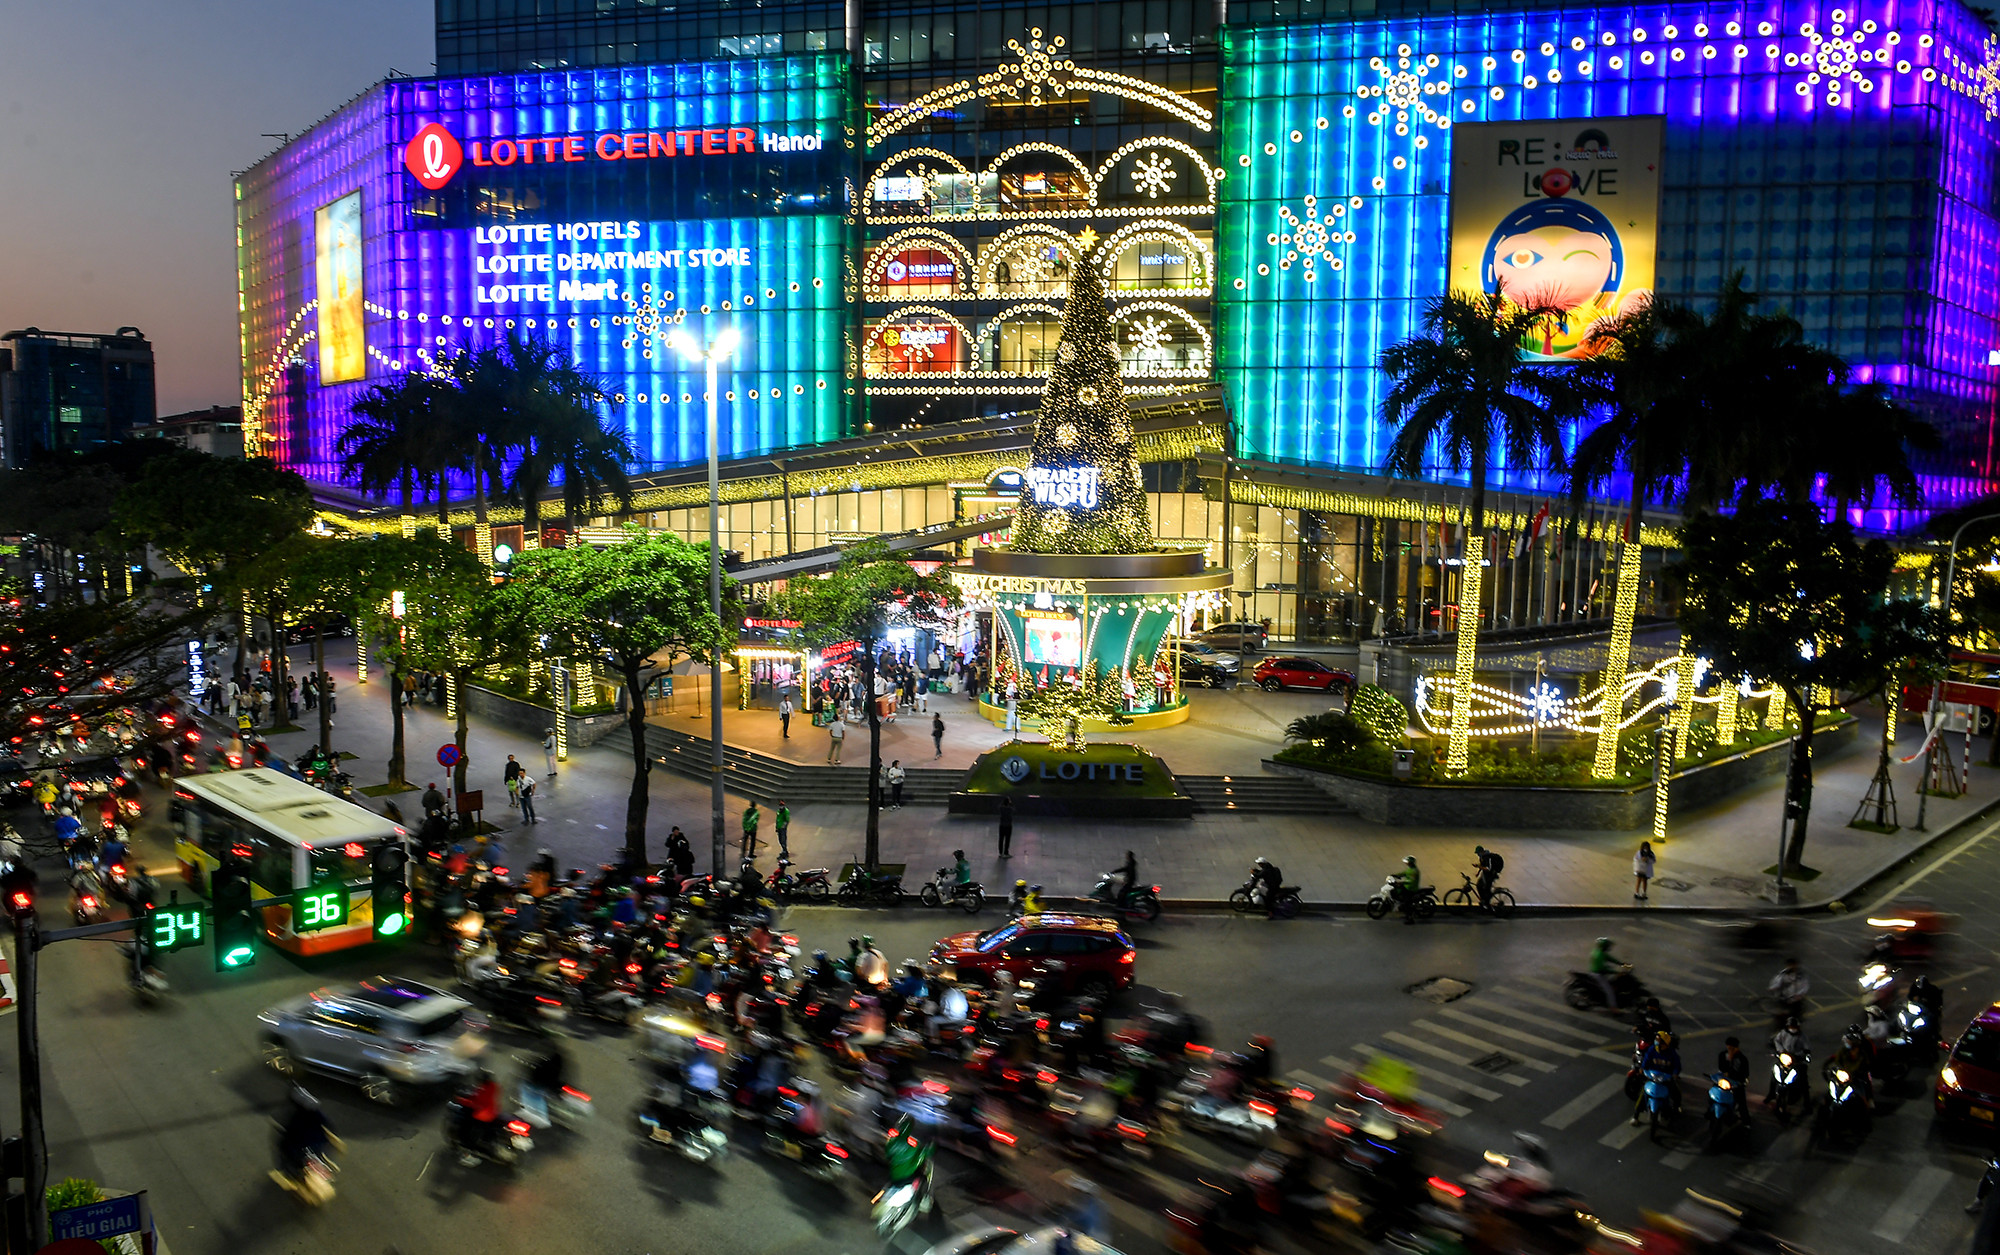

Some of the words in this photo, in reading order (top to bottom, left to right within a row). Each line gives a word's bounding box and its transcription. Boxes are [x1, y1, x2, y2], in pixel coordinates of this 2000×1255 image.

[473, 136, 585, 167] LOTTE
[596, 127, 756, 162] CENTER
[763, 130, 822, 154] Hanoi
[476, 223, 552, 245] LOTTE
[557, 220, 641, 242] HOTELS
[476, 253, 553, 275] LOTTE
[557, 249, 684, 272] DEPARTMENT
[688, 248, 751, 267] STORE
[477, 284, 553, 304] LOTTE
[558, 278, 619, 302] Mart
[988, 577, 1087, 594] CHRISTMAS
[1039, 761, 1144, 781] LOTTE
[304, 893, 341, 925] 36
[154, 911, 201, 947] 34
[99, 1214, 132, 1232] GIAI
